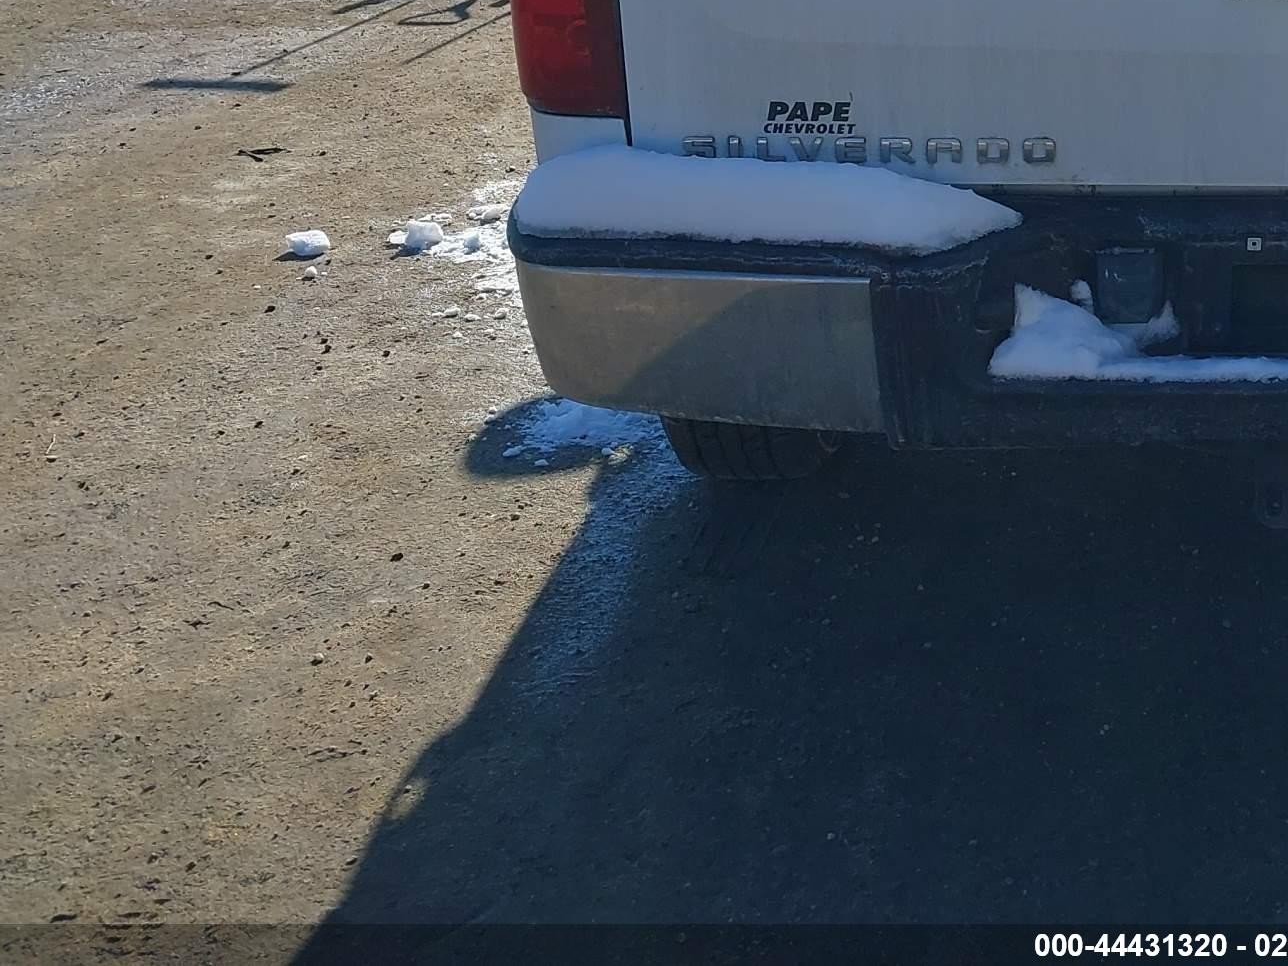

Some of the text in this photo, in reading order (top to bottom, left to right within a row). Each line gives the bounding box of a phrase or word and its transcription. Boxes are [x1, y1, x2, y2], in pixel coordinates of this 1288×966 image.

[767, 101, 851, 121] PAPE
[763, 123, 856, 134] CHEVROLET
[682, 136, 1057, 164] SILVERADO
